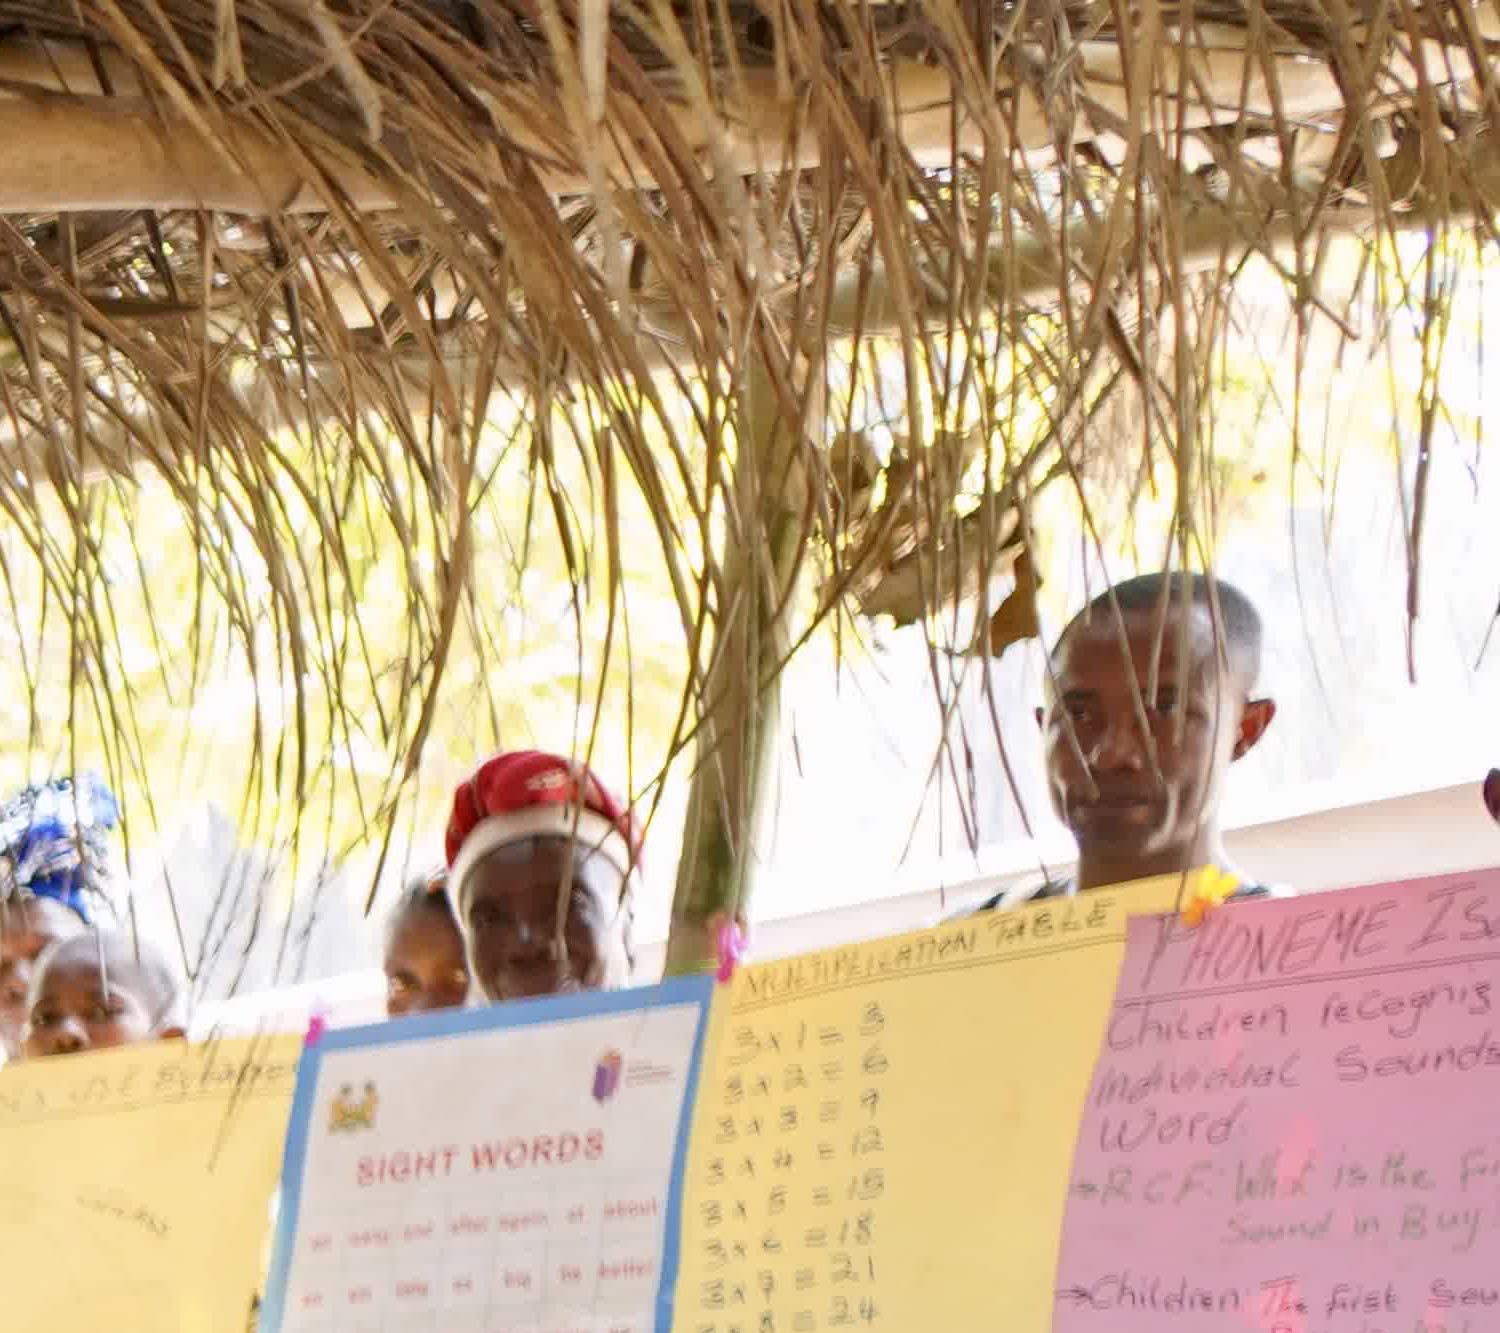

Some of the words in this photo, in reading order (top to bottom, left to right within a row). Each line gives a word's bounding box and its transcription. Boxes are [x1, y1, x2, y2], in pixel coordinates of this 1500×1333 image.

[987, 897, 1117, 948] TABLE
[1141, 898, 1398, 990] PHONEME
[355, 1143, 460, 1189] SIGHT
[470, 1127, 606, 1176] WORDS
